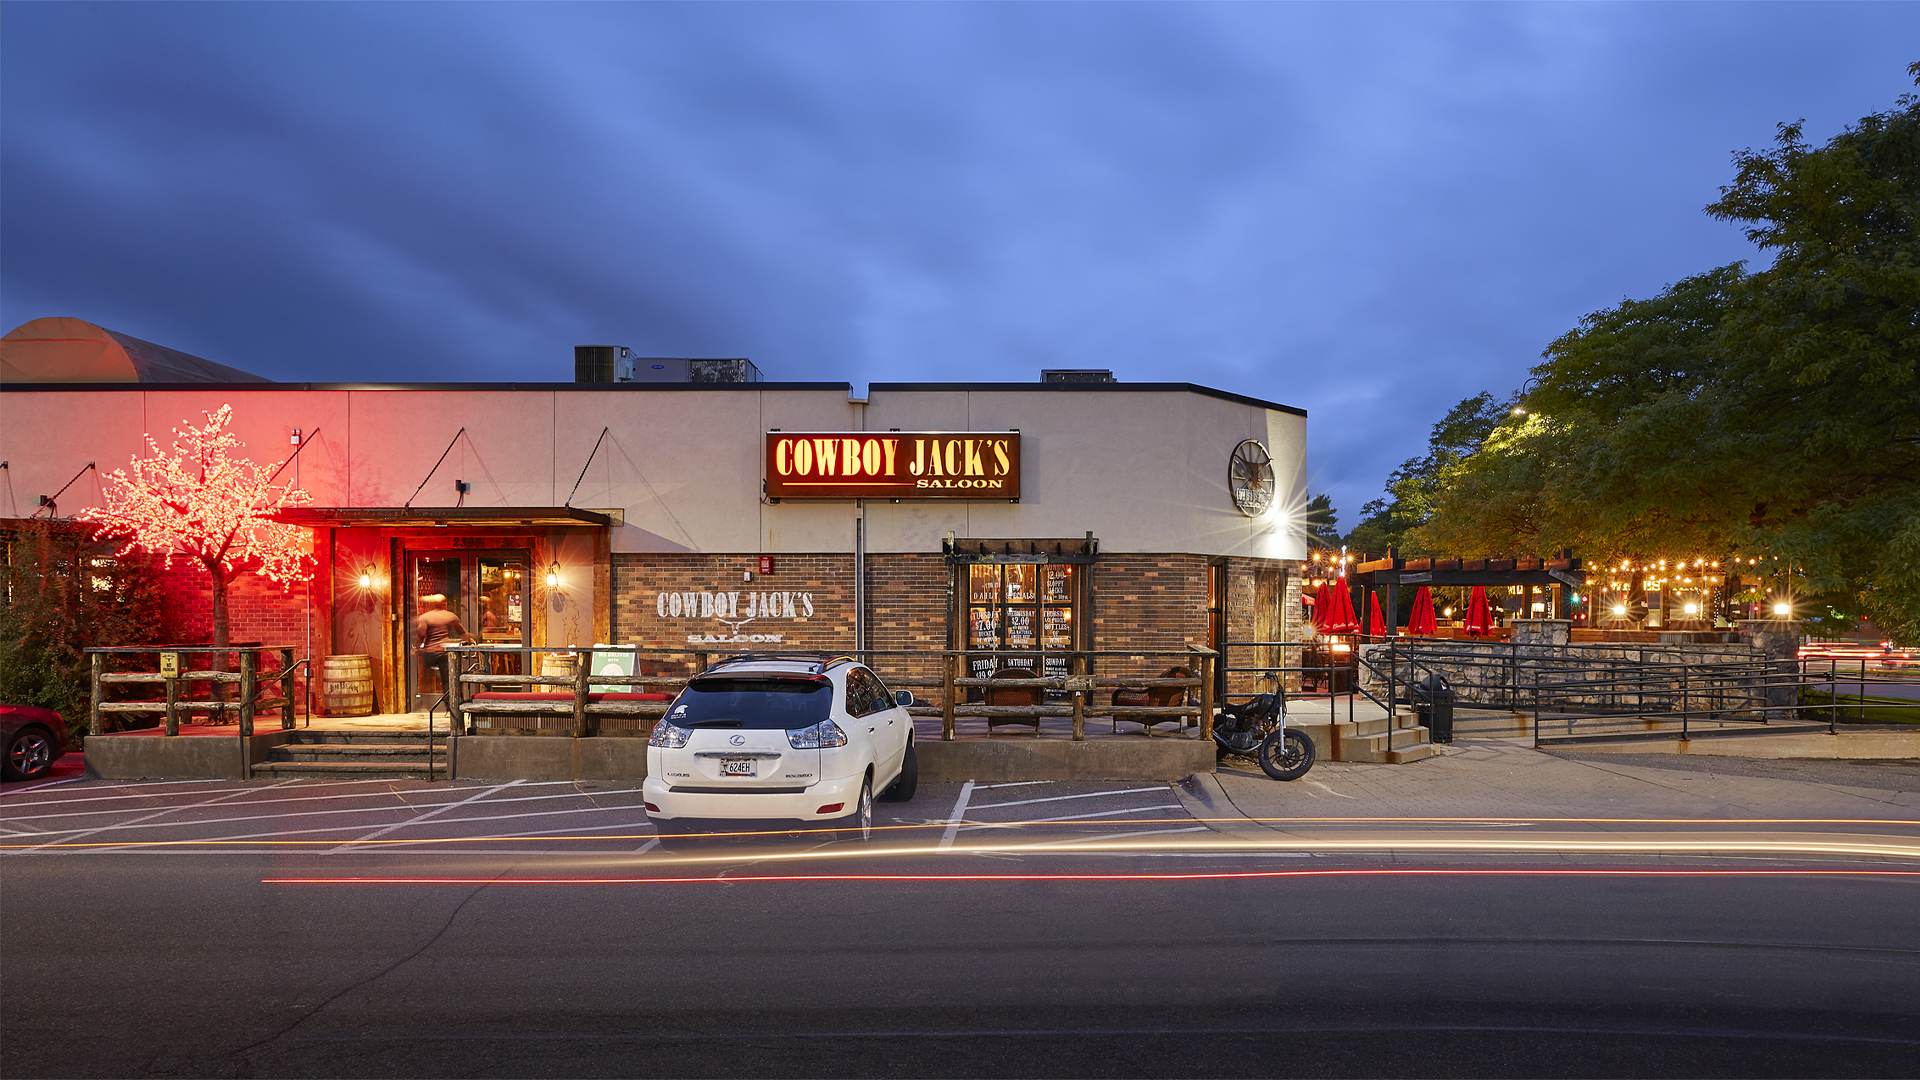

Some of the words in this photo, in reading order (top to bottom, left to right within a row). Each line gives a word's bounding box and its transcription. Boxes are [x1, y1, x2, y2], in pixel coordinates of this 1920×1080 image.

[776, 438, 899, 476] COWBOY
[909, 438, 1010, 476] JACK'S
[916, 479, 1003, 489] SALOON
[657, 592, 740, 618] COWBOY
[746, 592, 814, 618] JACK'S
[1011, 617, 1030, 626] $2.00
[687, 634, 783, 643] SALOON
[972, 658, 998, 671] FRIDAY
[1007, 658, 1033, 667] SATURDAY
[1046, 658, 1066, 666] SUNDAY
[730, 762, 750, 772] 624EH
